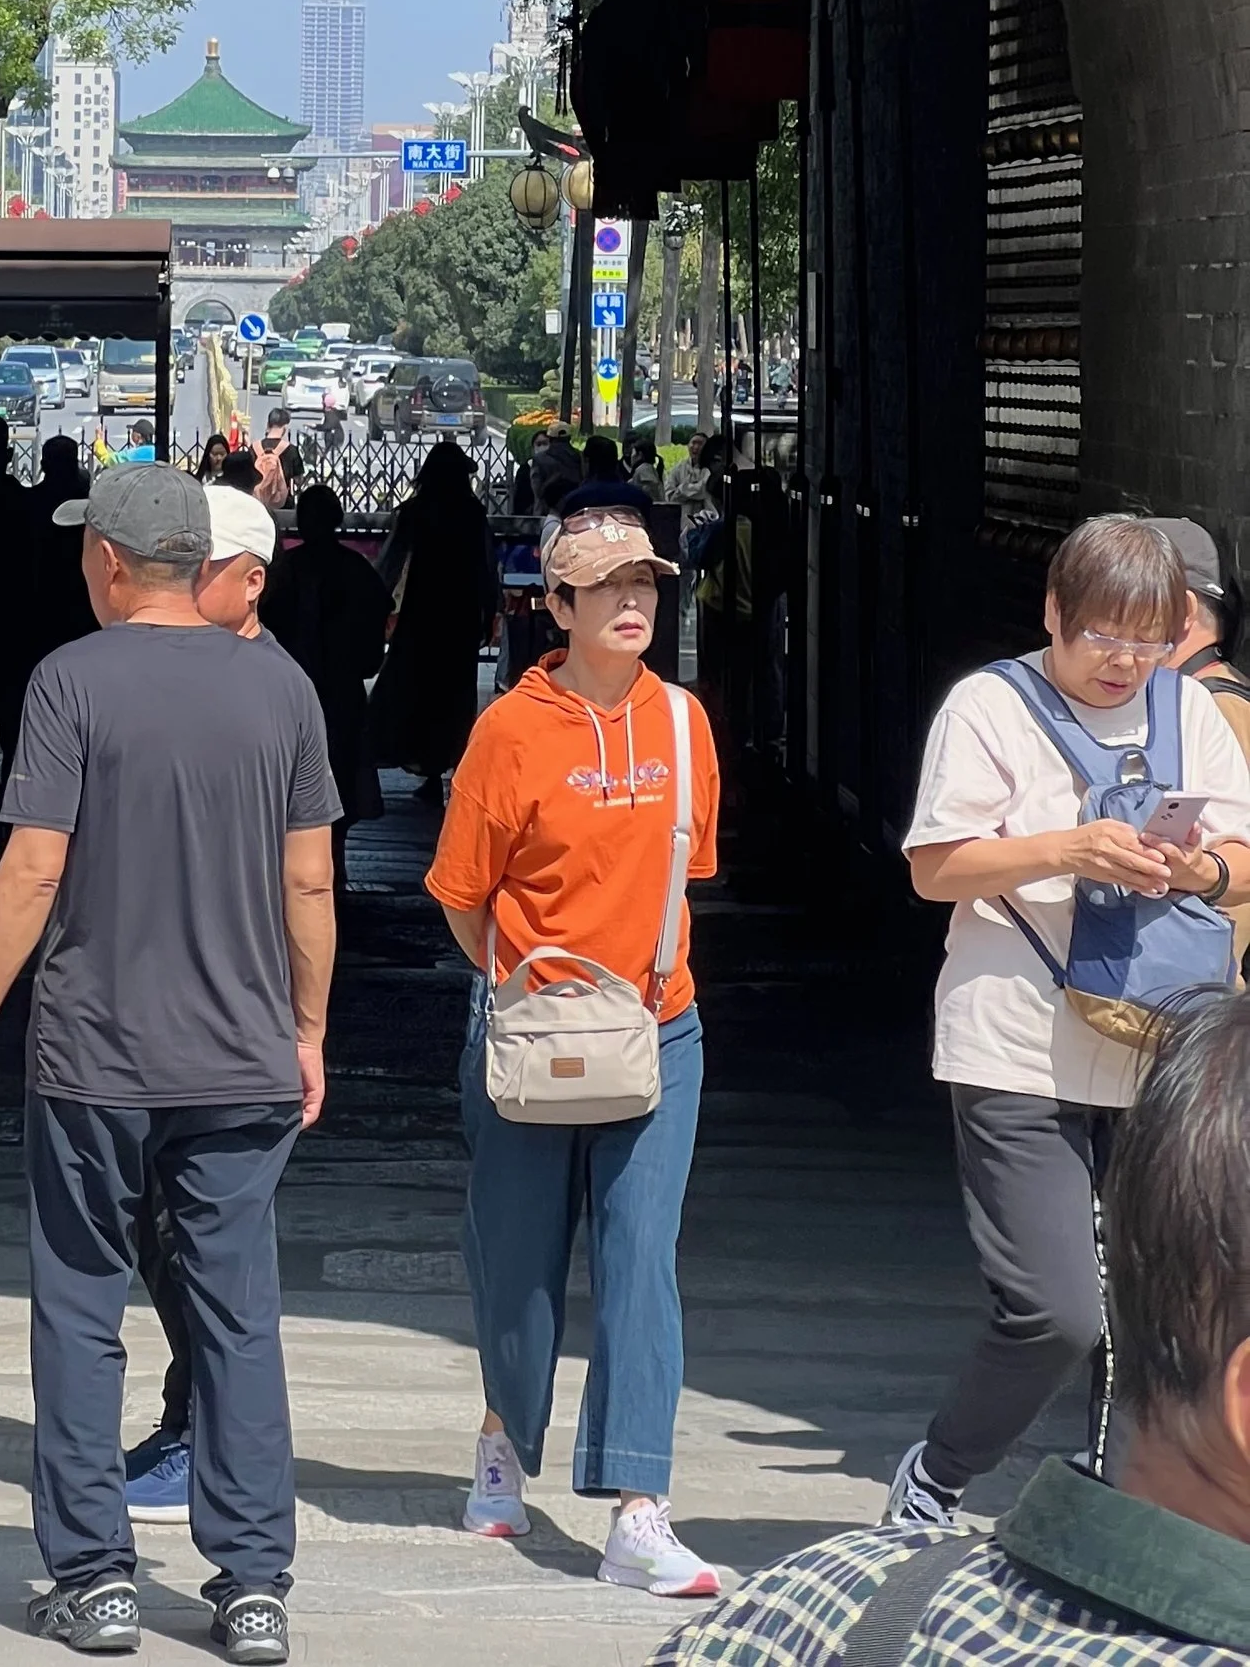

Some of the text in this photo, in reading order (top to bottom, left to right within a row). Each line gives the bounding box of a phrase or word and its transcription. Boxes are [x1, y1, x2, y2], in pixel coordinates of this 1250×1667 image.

[407, 144, 461, 161] 南大街
[412, 161, 455, 169] NAN DAJIE
[599, 524, 630, 543] Be
